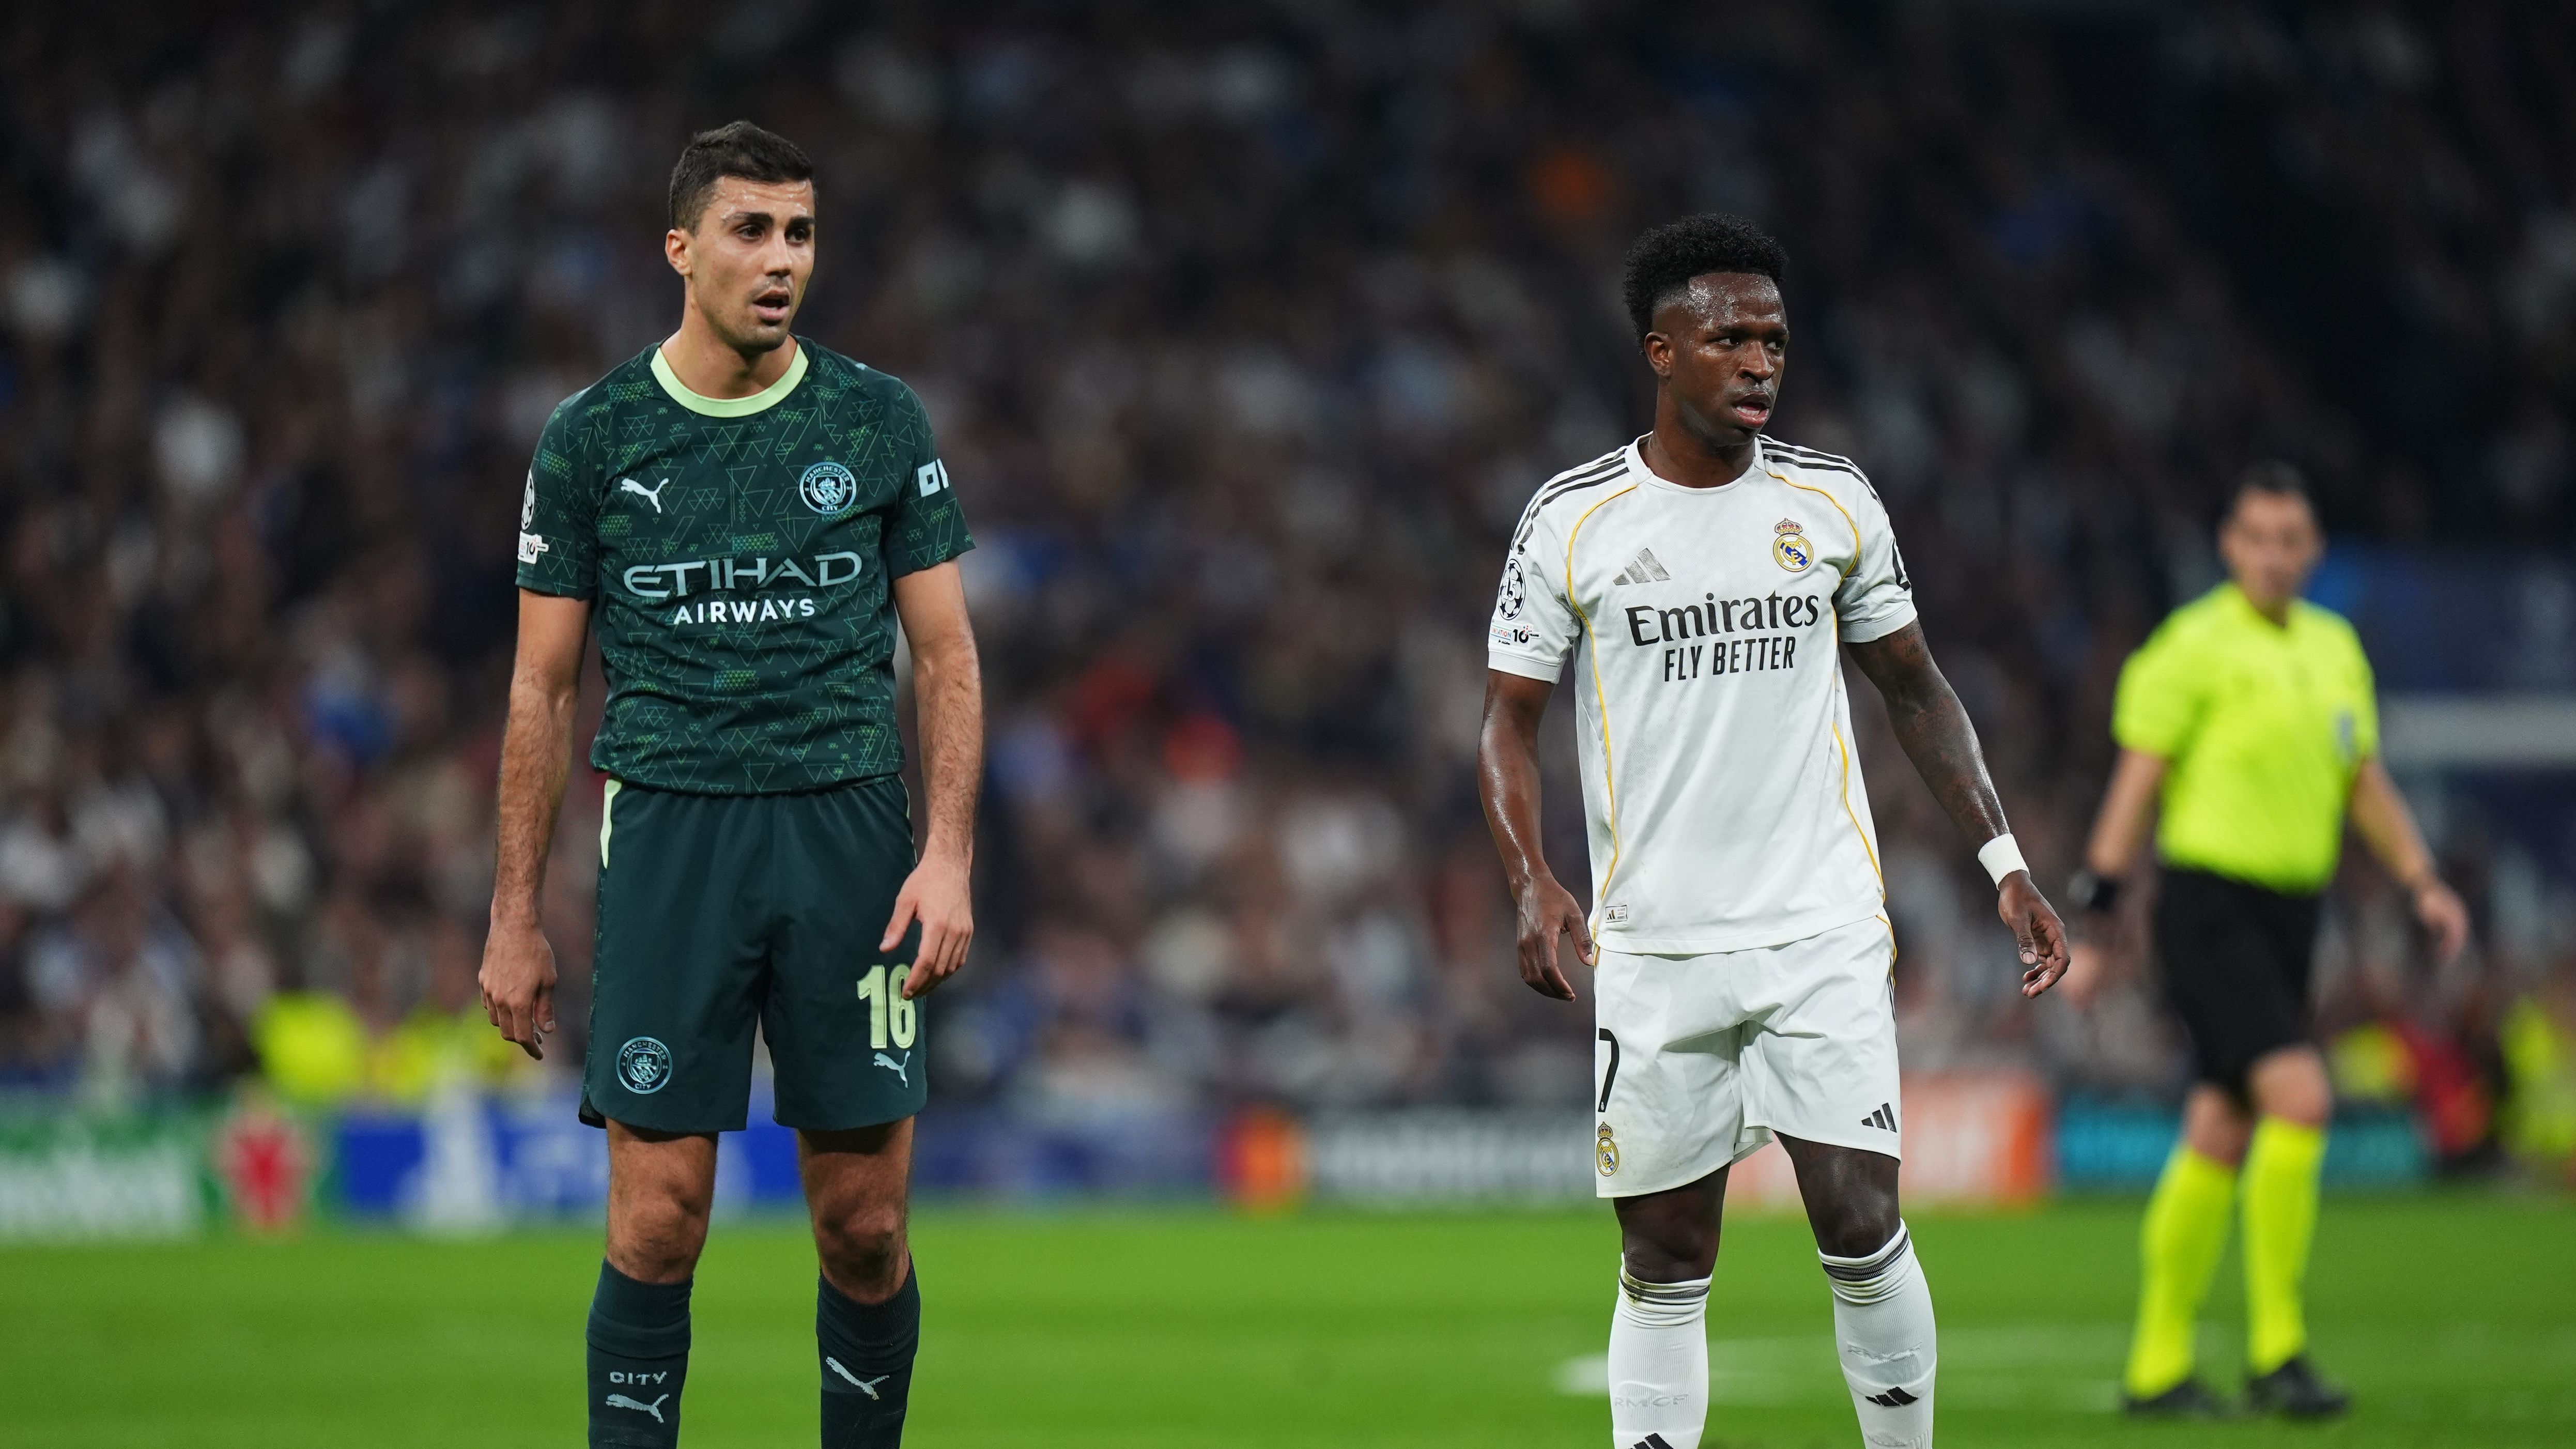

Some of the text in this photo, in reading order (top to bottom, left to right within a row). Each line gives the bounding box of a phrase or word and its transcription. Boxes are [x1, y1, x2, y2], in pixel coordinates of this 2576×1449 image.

[623, 551, 862, 598] ETIHAD
[673, 598, 815, 624] AIRWAYS
[1625, 590, 1819, 646] Emirates
[1664, 636, 1796, 682] FLY BETTER
[857, 963, 916, 1049] 16
[1598, 1028, 1619, 1112] 7
[610, 1371, 667, 1385] CITY
